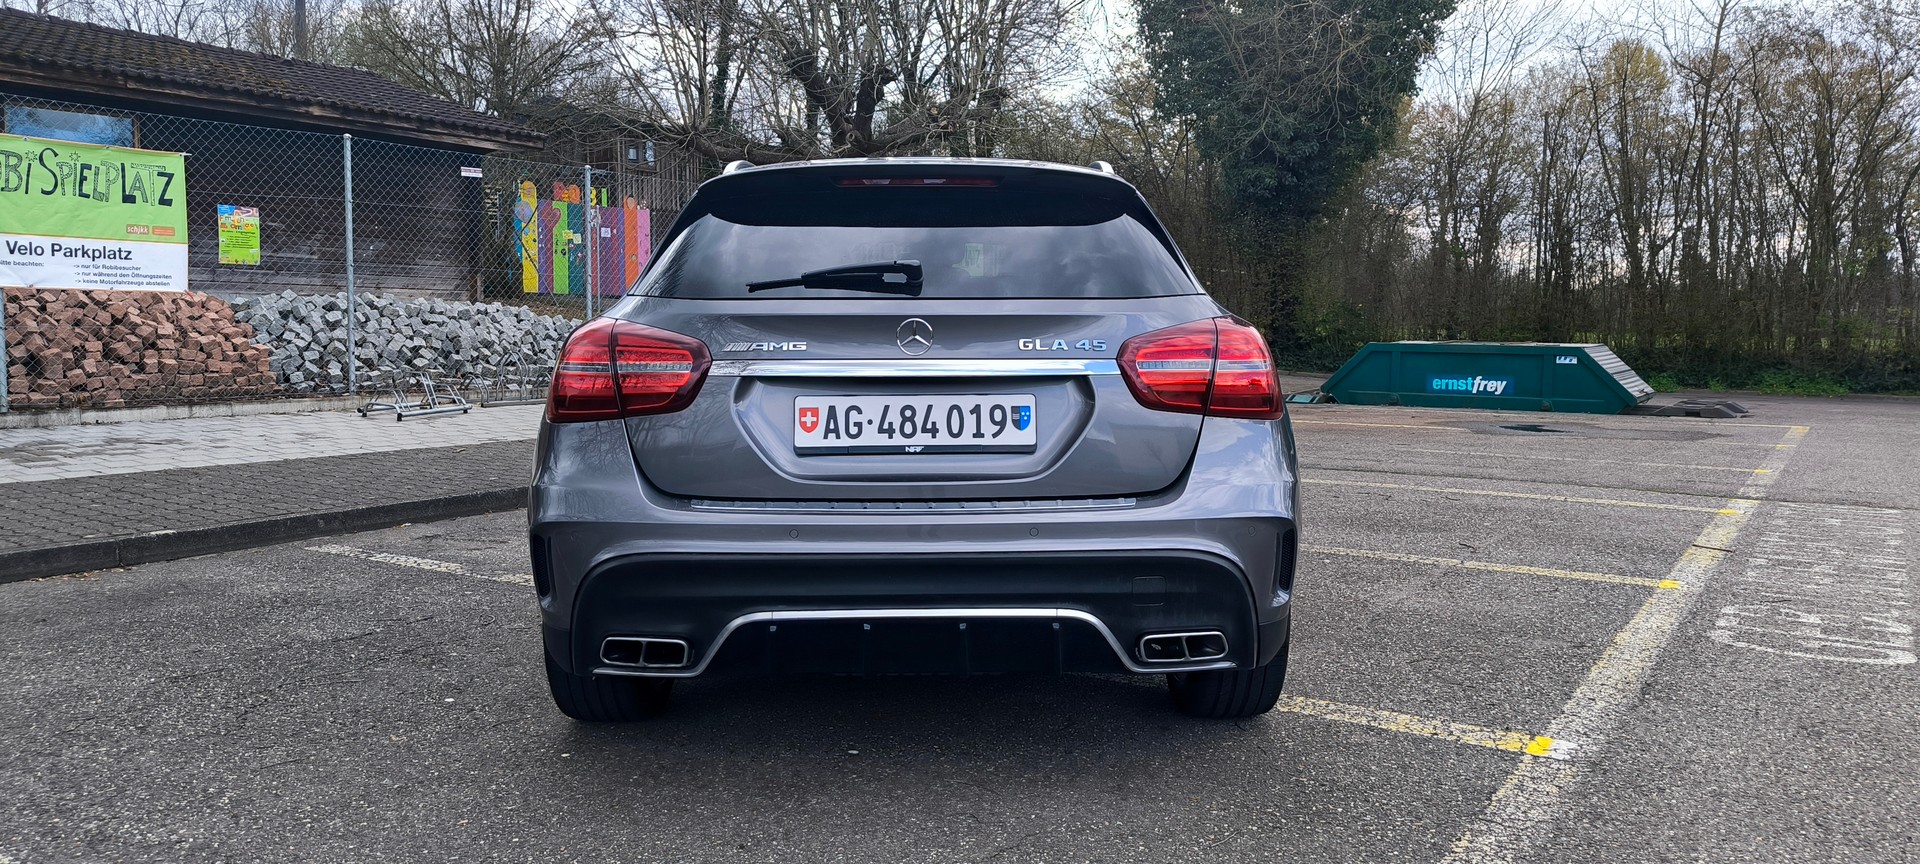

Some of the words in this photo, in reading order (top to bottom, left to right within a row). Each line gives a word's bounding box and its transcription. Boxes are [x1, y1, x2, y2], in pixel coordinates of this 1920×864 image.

[5, 240, 45, 256] Velo
[51, 243, 133, 262] Parkplatz
[12, 260, 45, 268] beachten:
[131, 272, 172, 280] Öffnungszeiten
[99, 279, 144, 287] Motorfahrzeuge
[749, 341, 807, 352] AMG
[1018, 338, 1069, 351] GLA
[1075, 339, 1107, 351] 45
